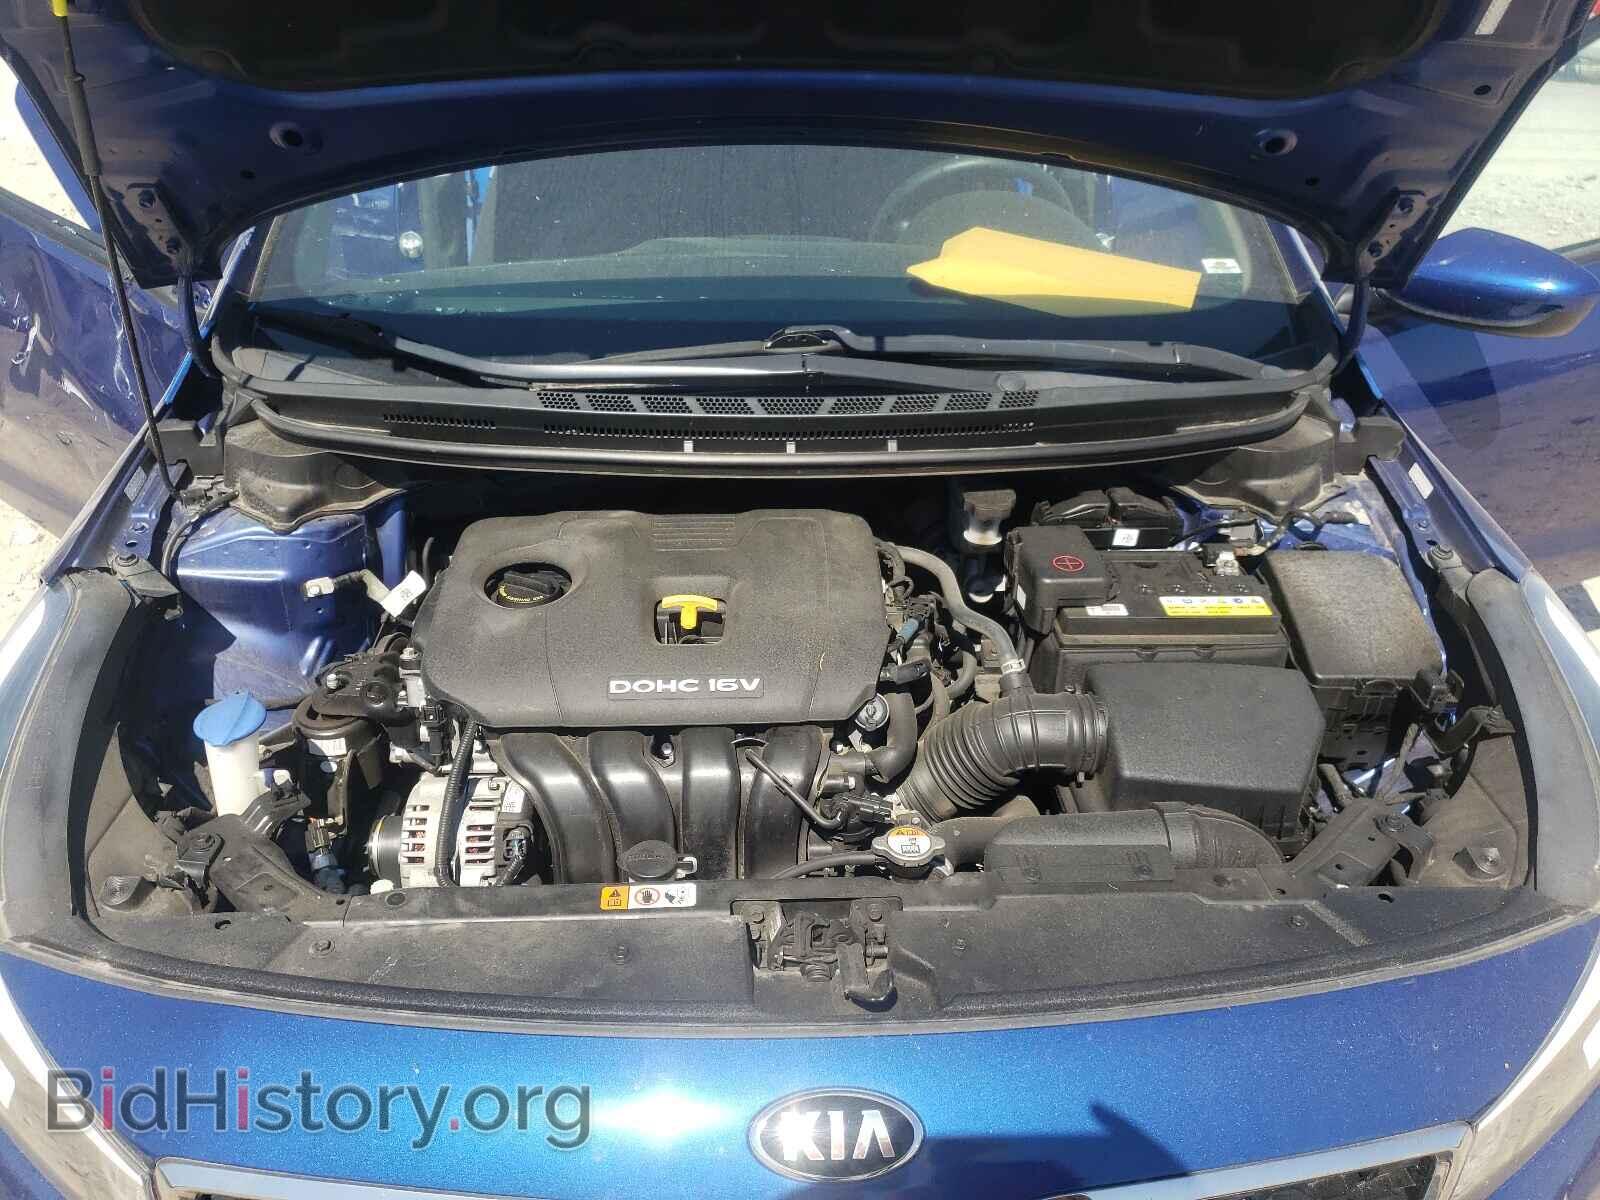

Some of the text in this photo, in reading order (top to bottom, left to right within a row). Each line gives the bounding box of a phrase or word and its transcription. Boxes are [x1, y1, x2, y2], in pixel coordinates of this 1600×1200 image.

[609, 678, 761, 694] DOHC 16V
[780, 1110, 897, 1161] KIA
